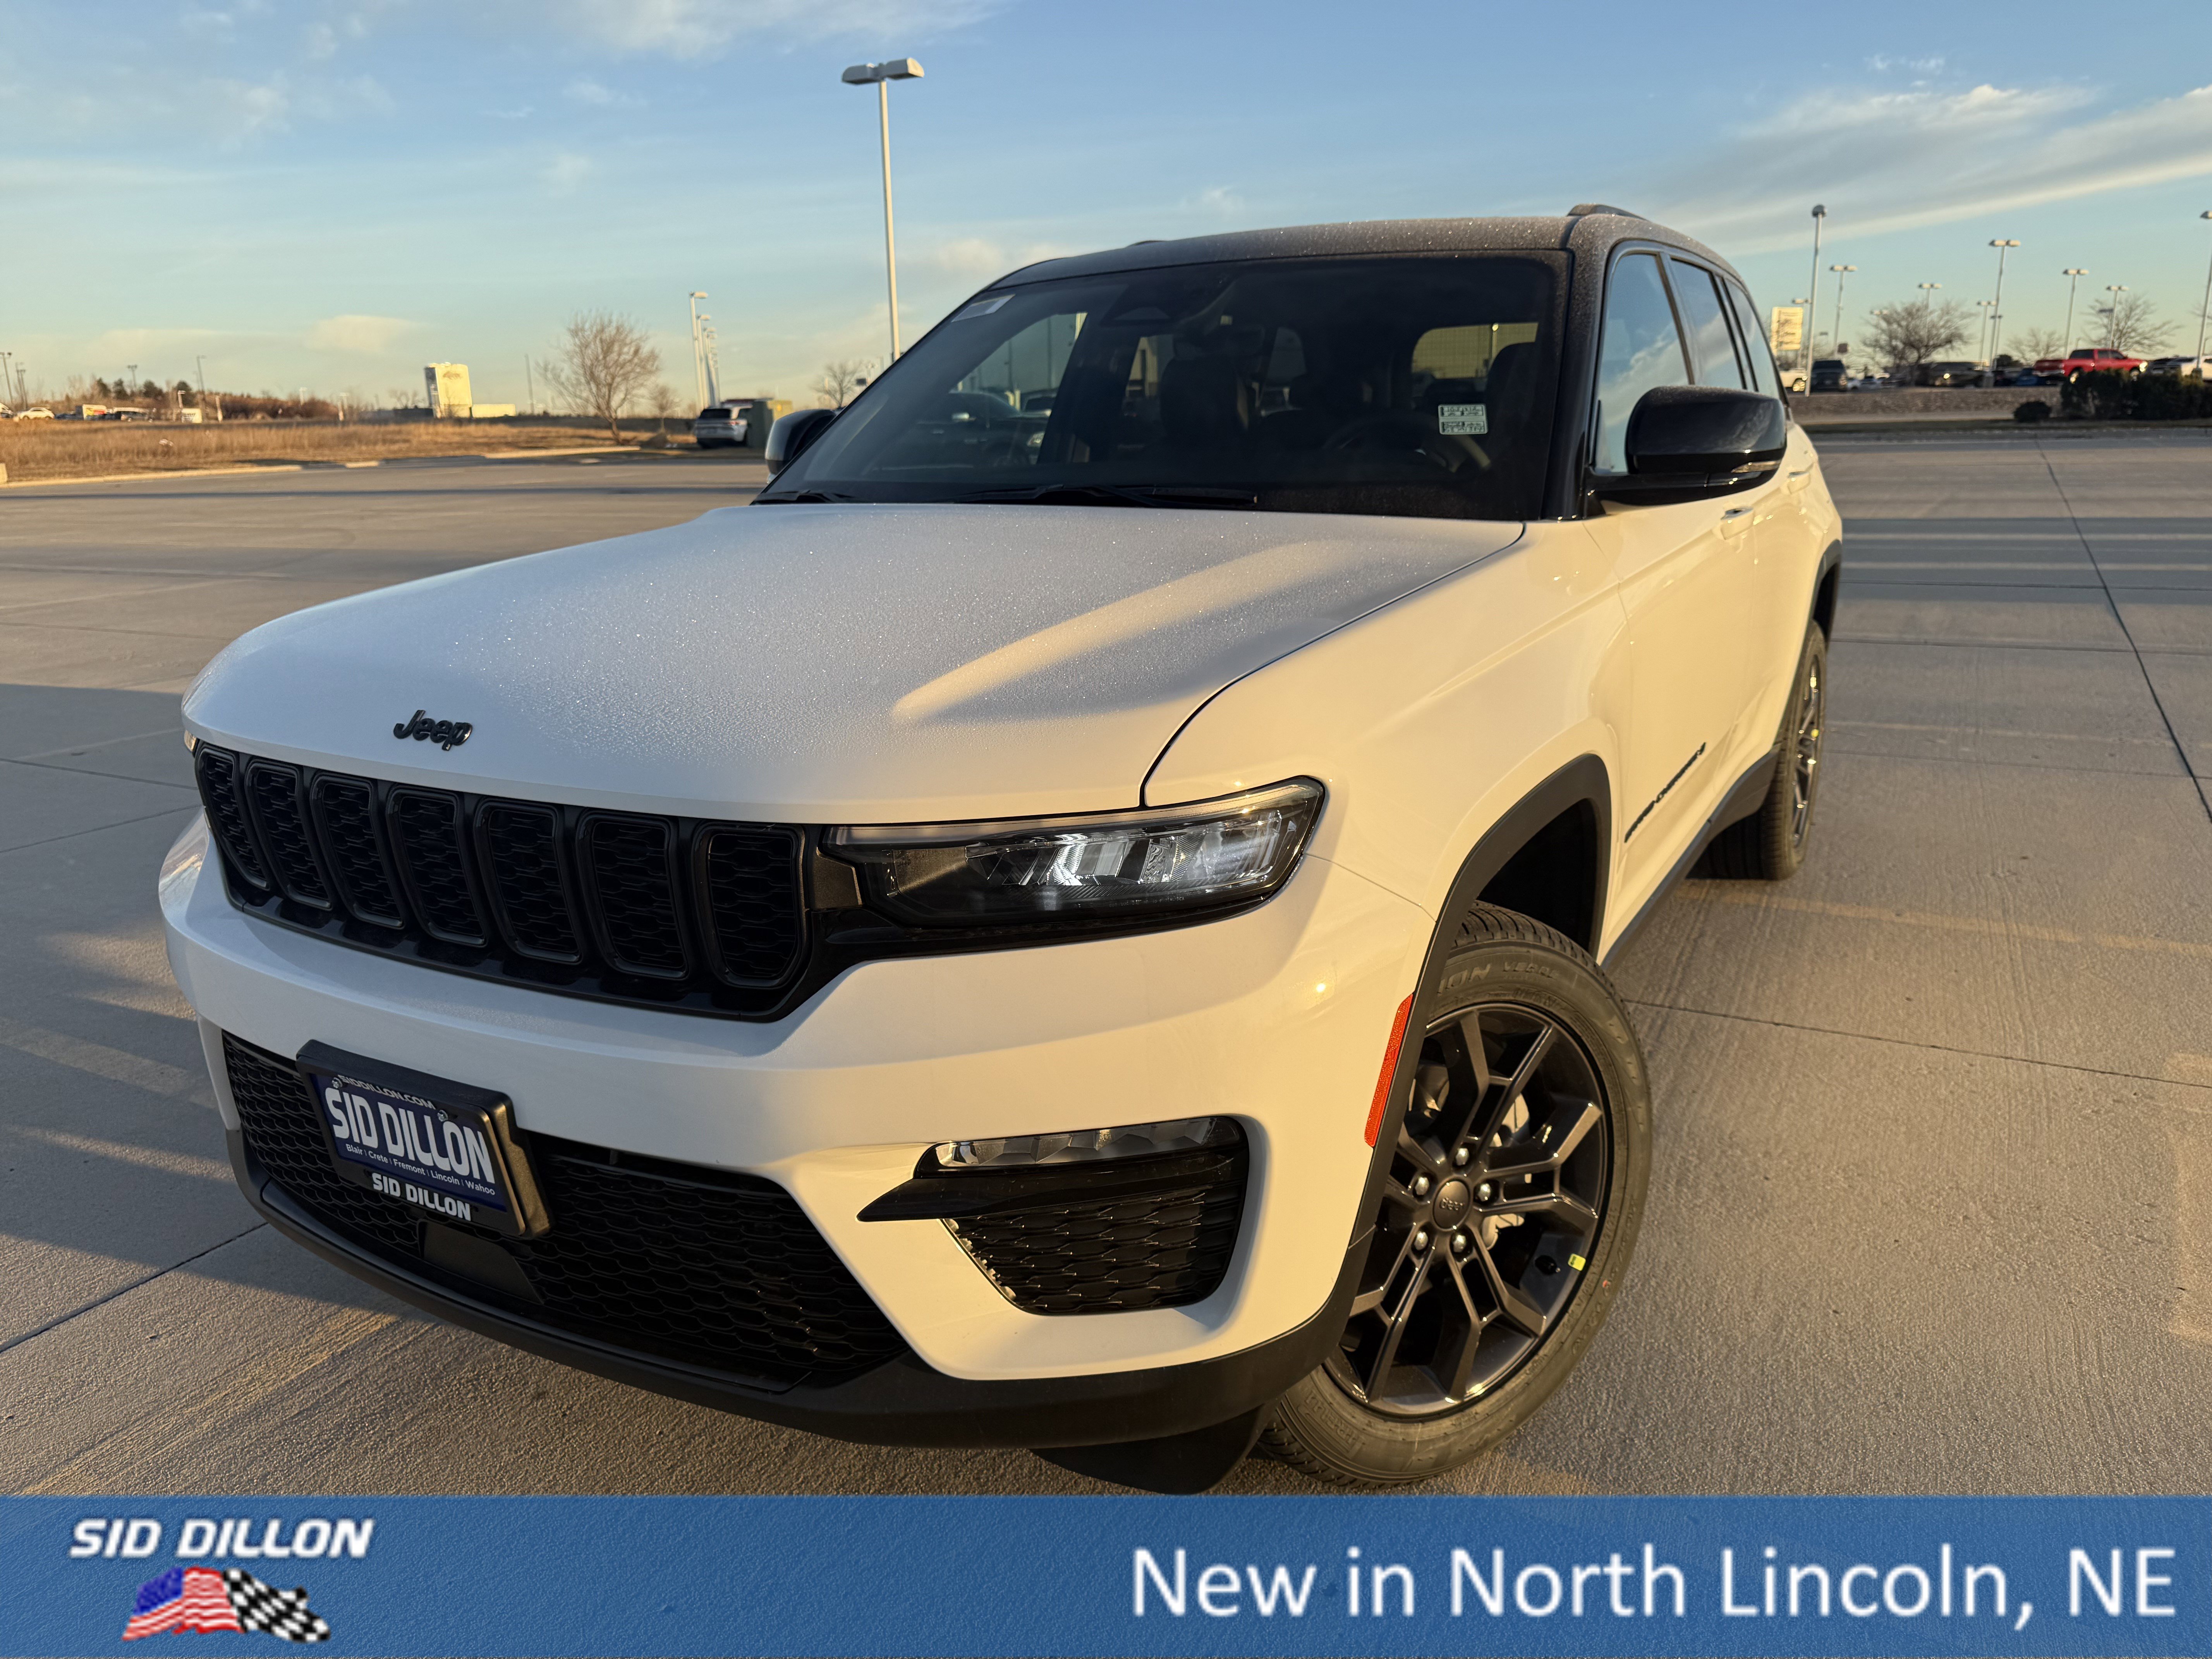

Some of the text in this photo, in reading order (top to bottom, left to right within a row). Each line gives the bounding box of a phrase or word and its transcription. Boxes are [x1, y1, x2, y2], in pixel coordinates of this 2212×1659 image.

[393, 709, 473, 751] Jeep
[338, 1074, 436, 1110] SIDDILLON.COM
[325, 1087, 496, 1184] SID DILLON
[346, 1143, 496, 1195] Blair Crete Fremont Lincoln Wahoo
[371, 1172, 471, 1222] SID DILLON
